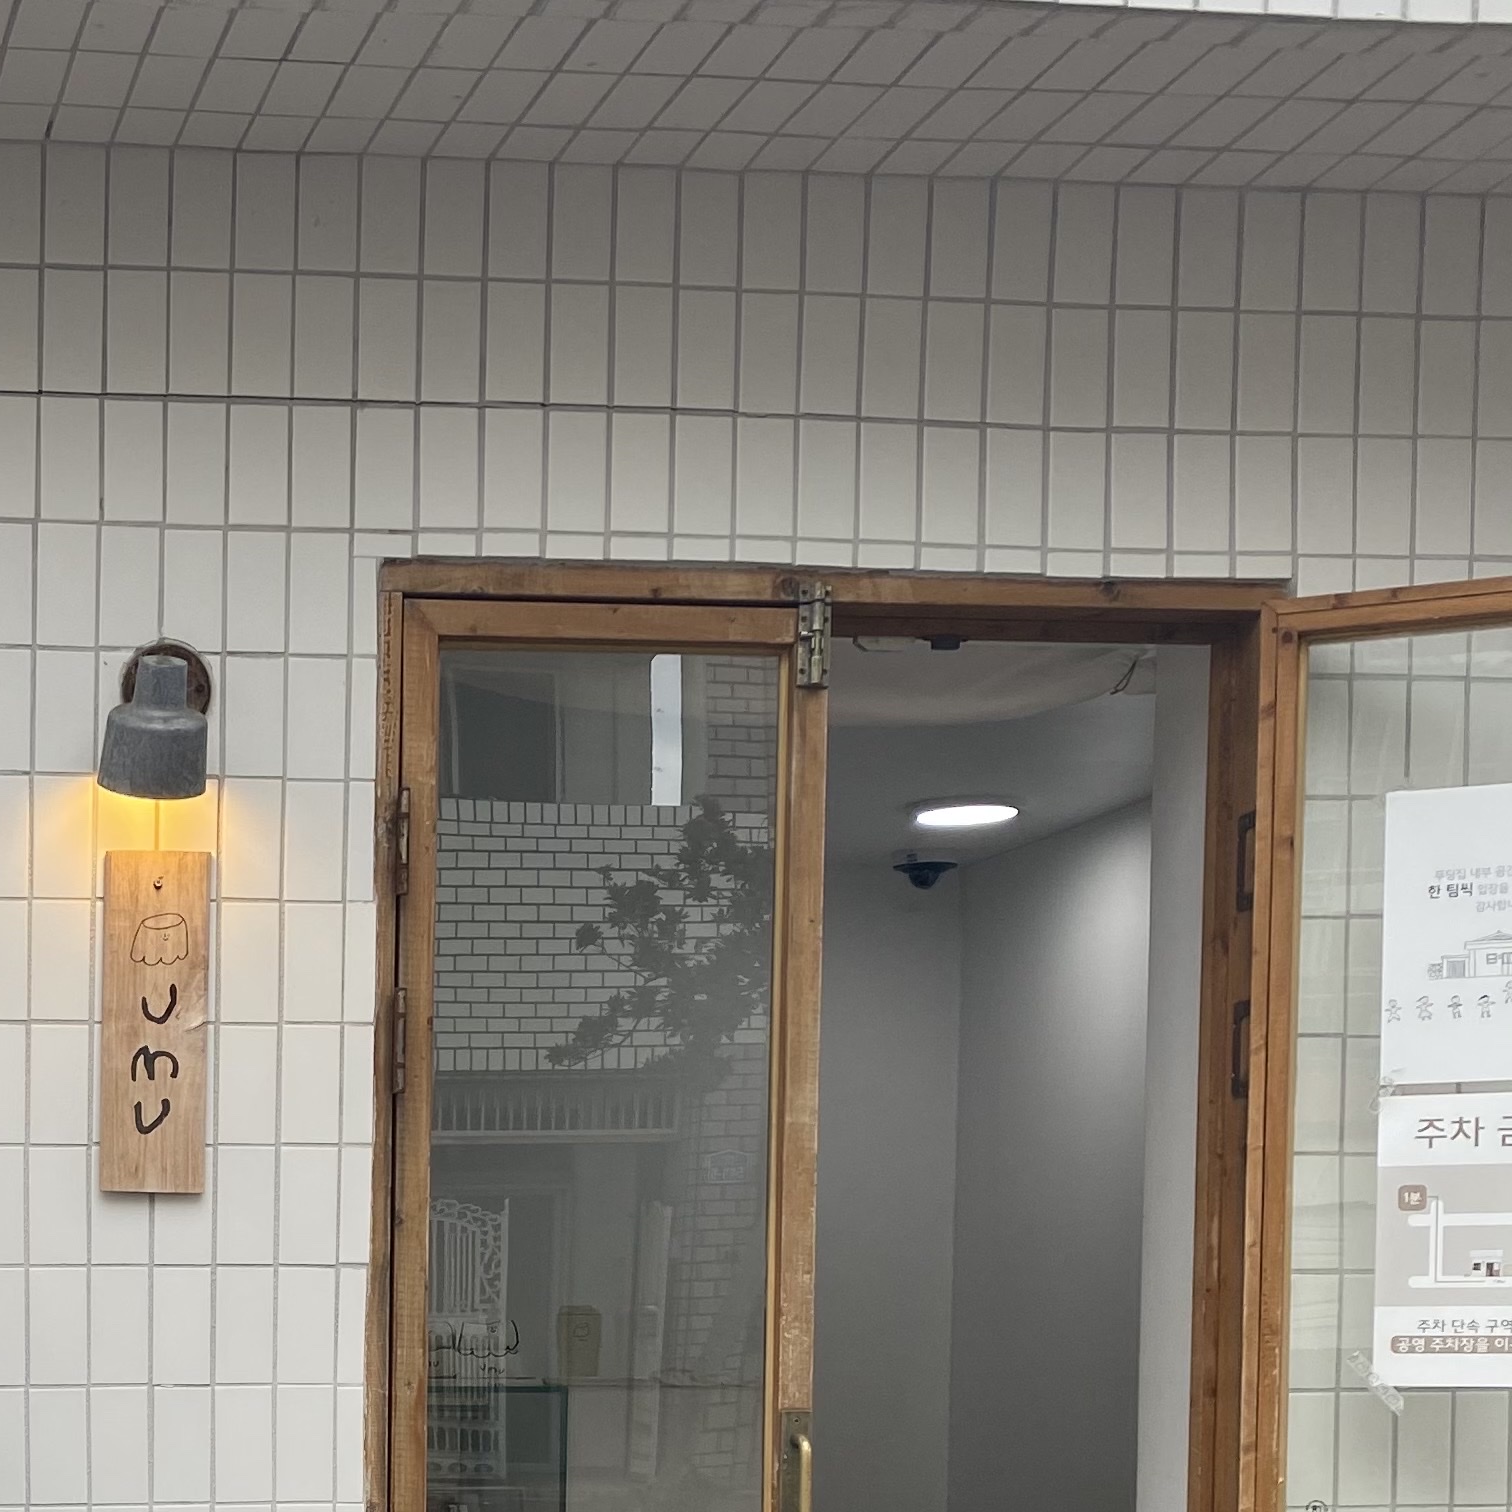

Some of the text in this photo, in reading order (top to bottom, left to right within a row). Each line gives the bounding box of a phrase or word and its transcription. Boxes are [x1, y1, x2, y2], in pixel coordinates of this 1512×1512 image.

[1428, 884, 1441, 899] 한
[1446, 882, 1473, 898] 팀씩
[1414, 1116, 1485, 1149] 주차
[1403, 1191, 1422, 1205] 1분
[1417, 1319, 1512, 1333] 주차 단속 구역
[1396, 1337, 1512, 1353] 공영 주차장을 이
